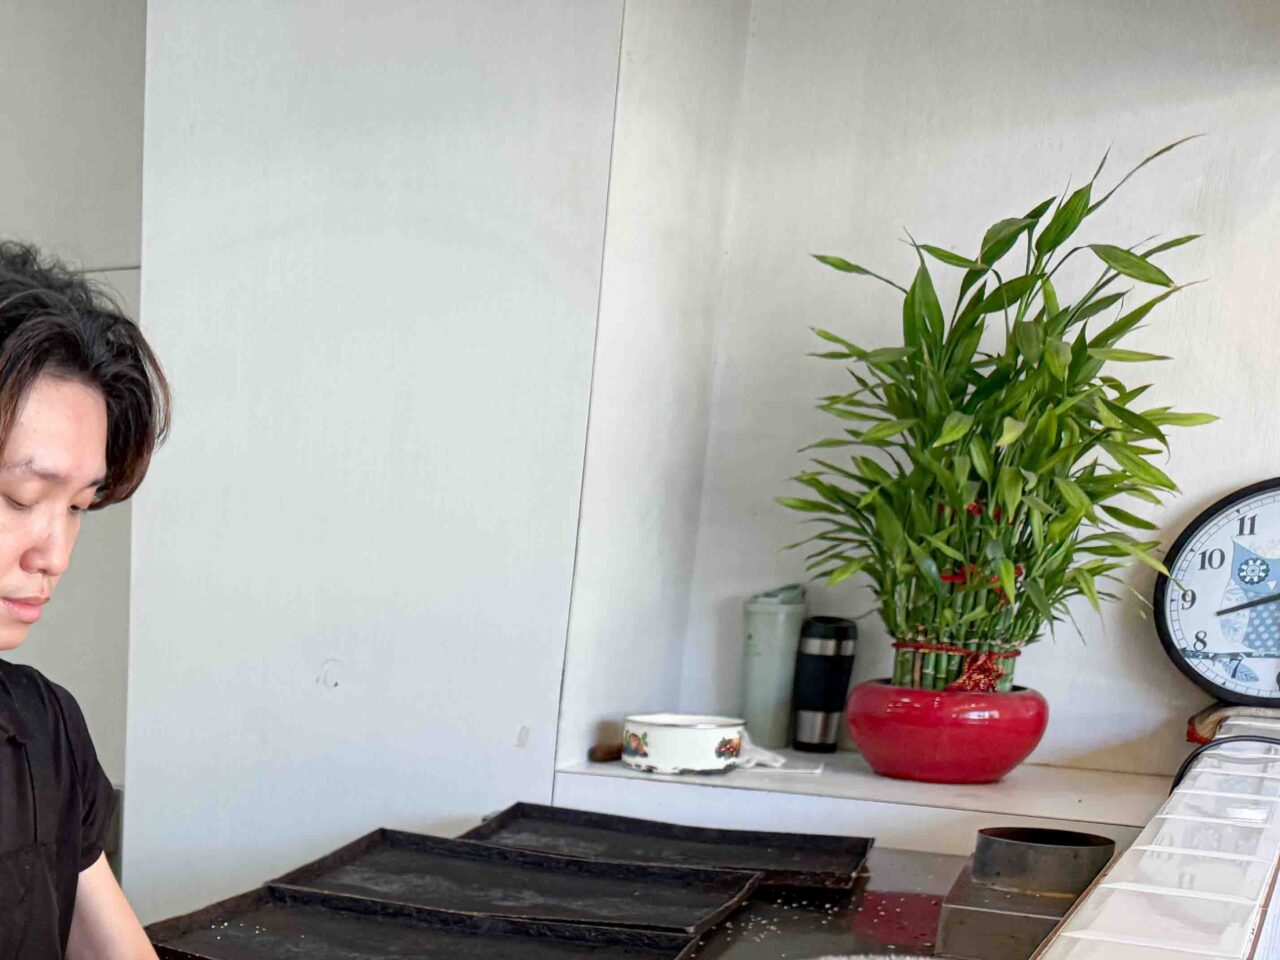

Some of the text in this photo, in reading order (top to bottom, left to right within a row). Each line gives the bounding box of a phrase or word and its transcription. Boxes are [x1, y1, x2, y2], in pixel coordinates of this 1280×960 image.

[1237, 514, 1257, 536] 11
[1198, 548, 1225, 571] 10
[1181, 589, 1197, 611] 9
[1193, 630, 1207, 652] 8
[1229, 656, 1243, 679] 7
